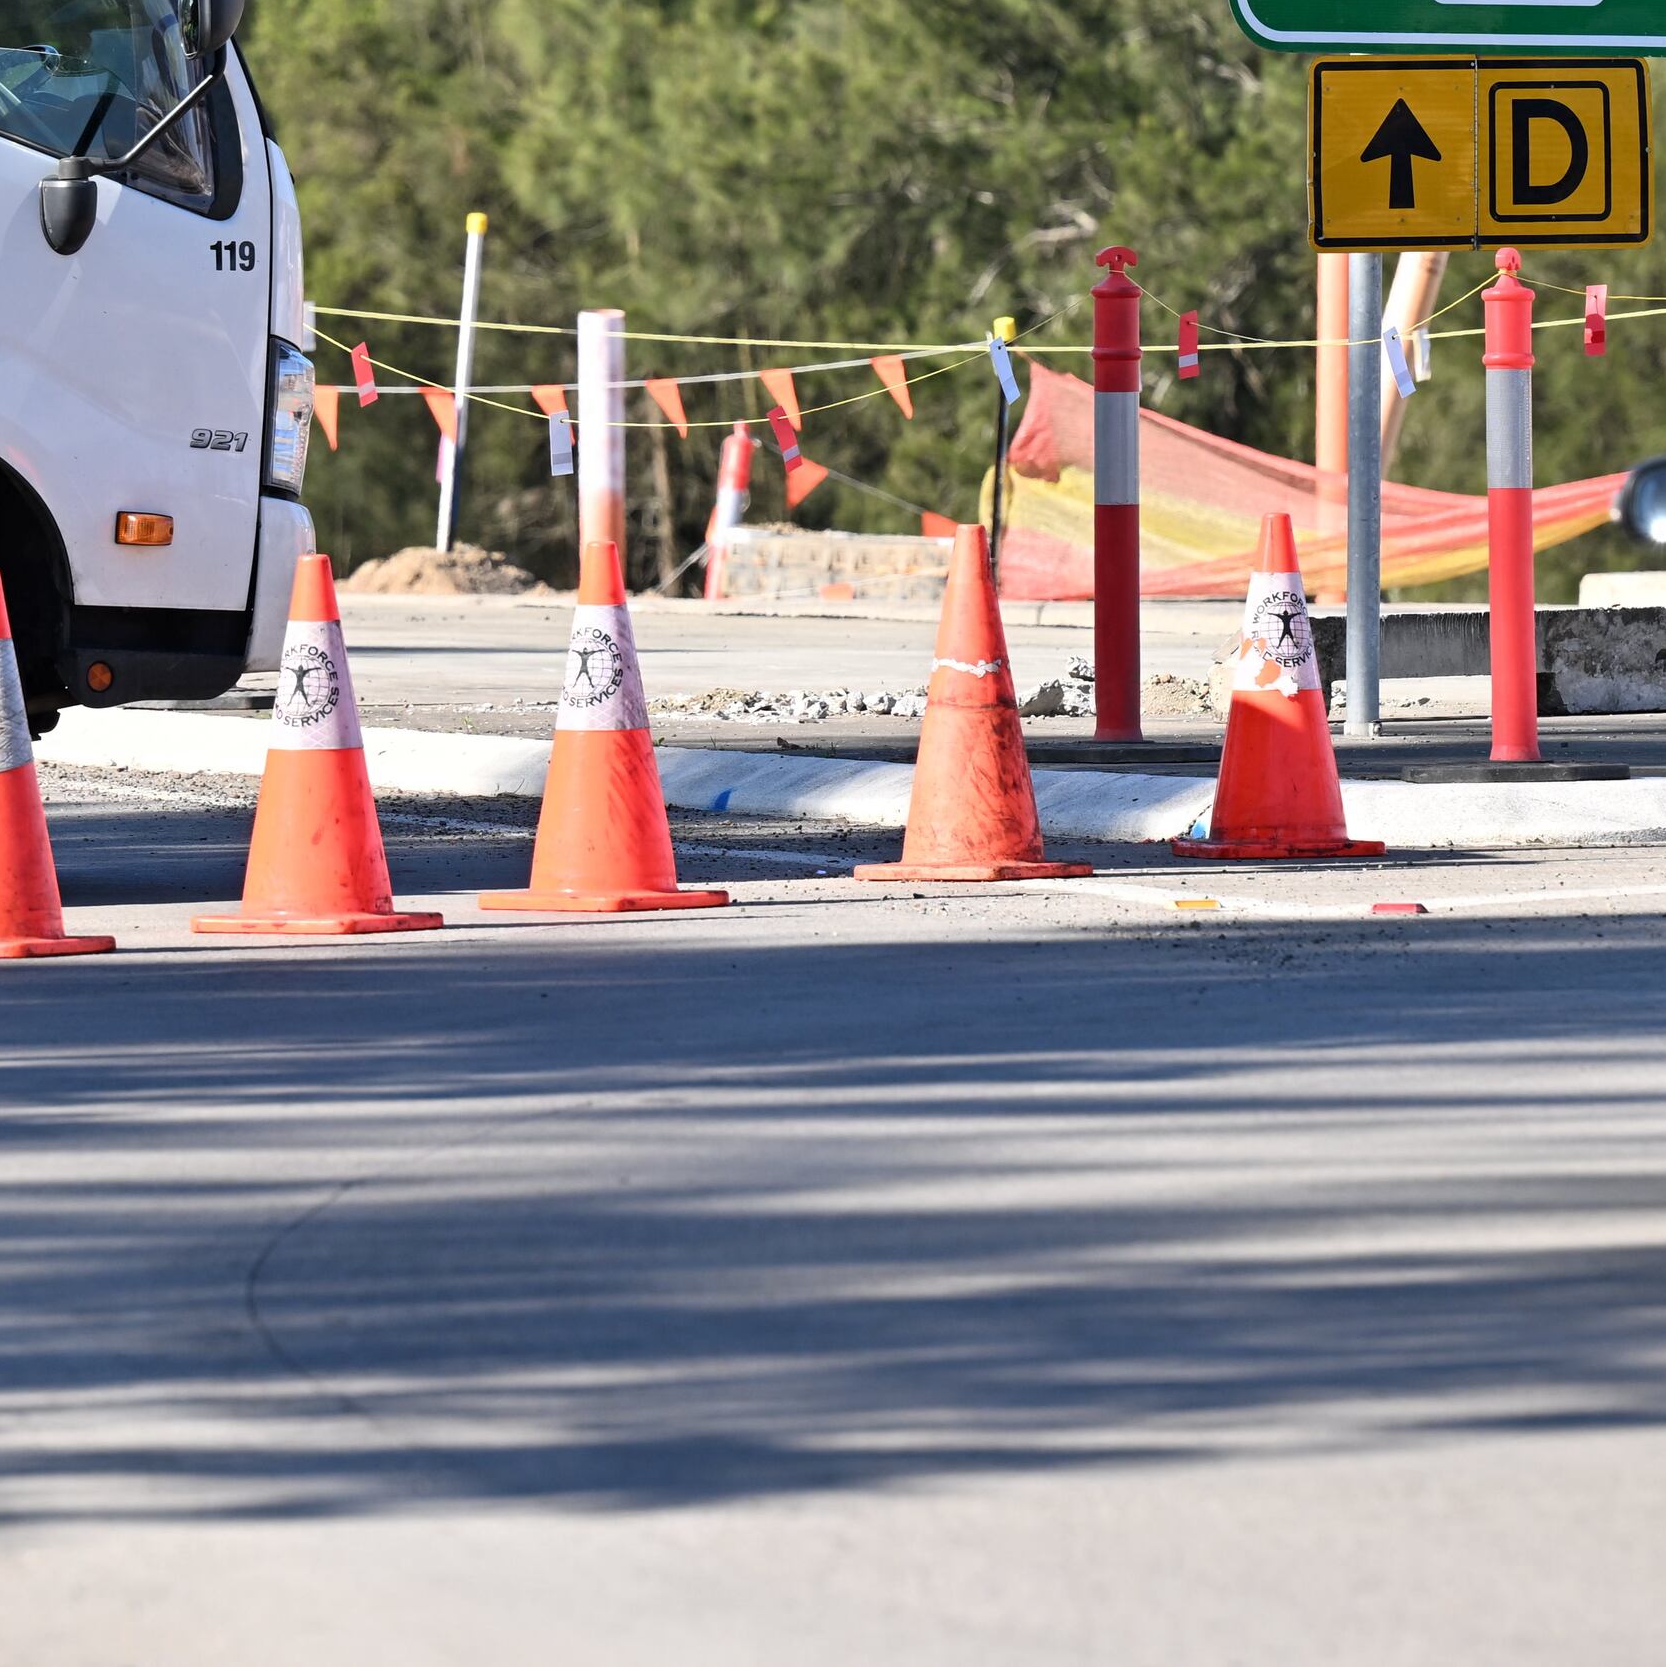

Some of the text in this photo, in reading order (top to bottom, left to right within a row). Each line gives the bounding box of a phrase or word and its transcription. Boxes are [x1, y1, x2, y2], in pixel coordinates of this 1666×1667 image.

[1511, 98, 1589, 206] D
[209, 240, 256, 272] 119
[189, 429, 249, 453] 921
[283, 686, 340, 727] SERVICES
[569, 668, 624, 708] SERVICES
